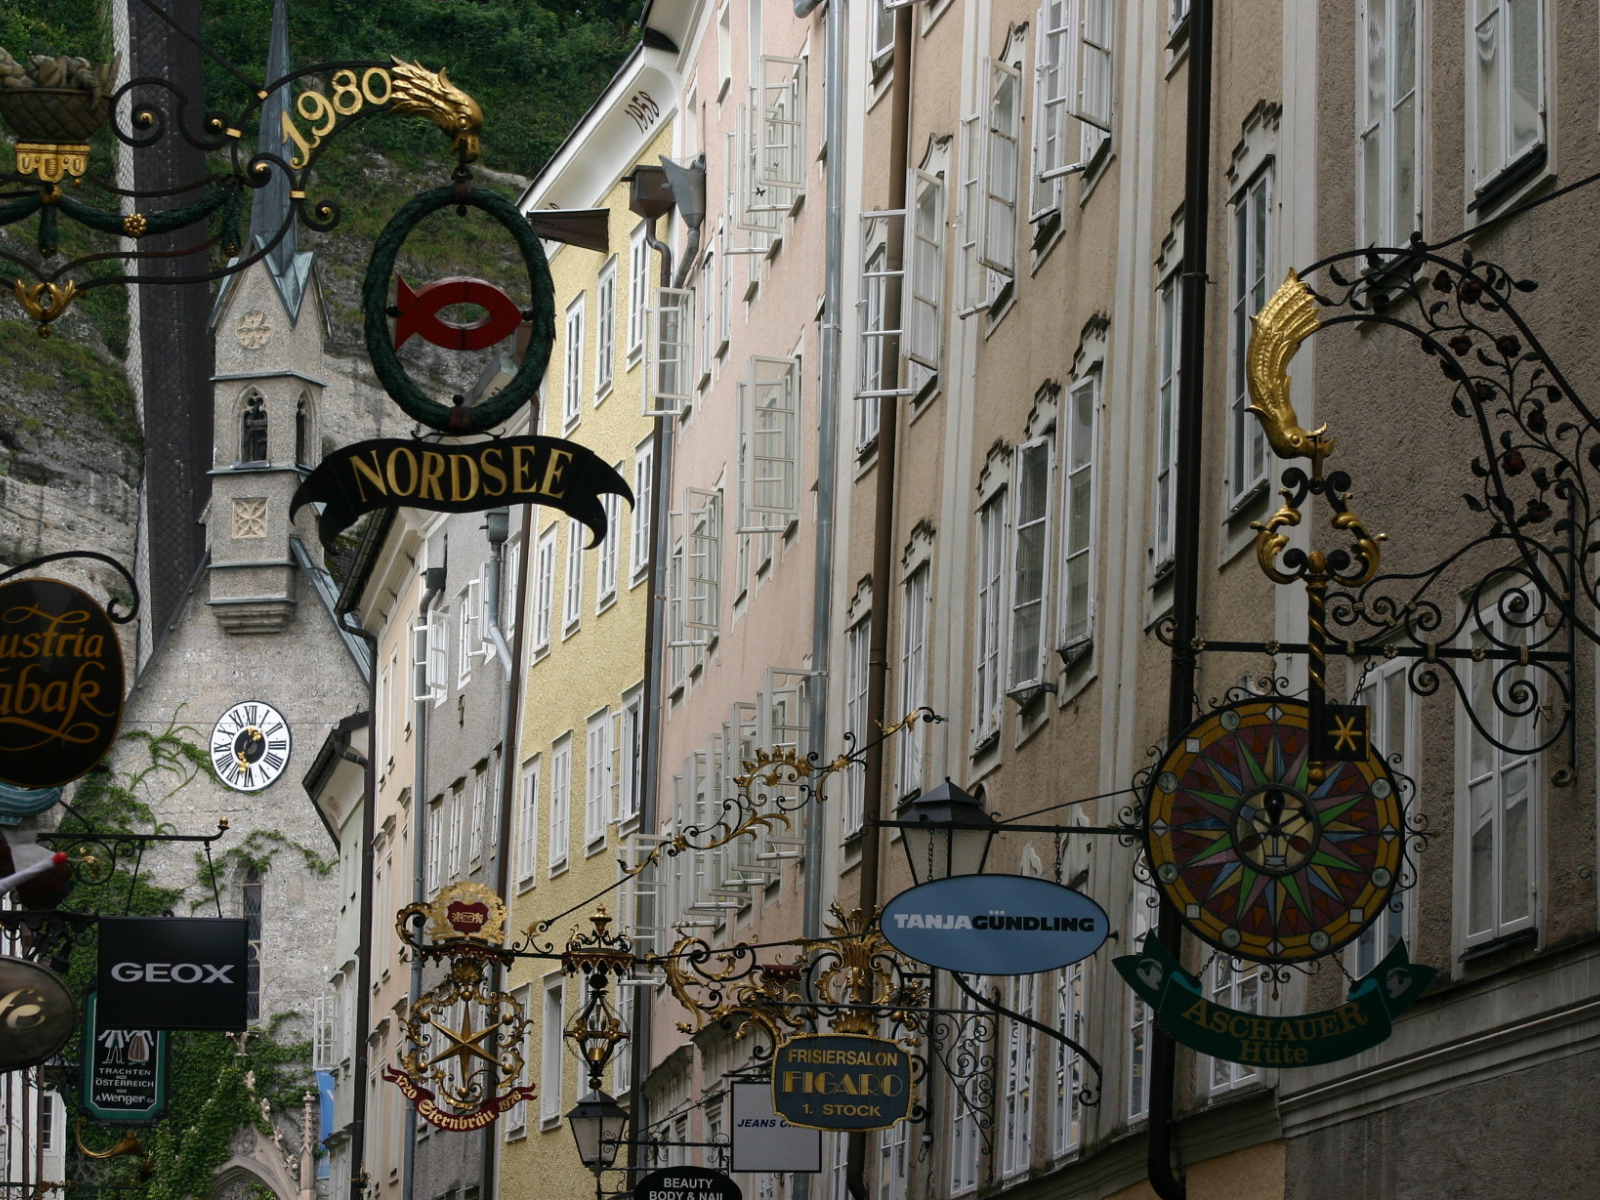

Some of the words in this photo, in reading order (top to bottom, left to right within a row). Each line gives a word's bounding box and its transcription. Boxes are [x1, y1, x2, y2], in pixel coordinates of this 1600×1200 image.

[281, 67, 391, 169] 1980
[624, 91, 659, 134] 1958
[349, 446, 573, 502] NORDSEE
[0, 603, 104, 658] ustria
[0, 661, 115, 735] abak
[111, 962, 235, 983] GEOX
[1180, 999, 1368, 1041] ASCHAUER
[788, 1049, 899, 1067] FRISIERSALON
[1238, 1039, 1309, 1064] Hüte
[95, 1077, 154, 1088] ÖSTERREICH
[99, 1067, 151, 1076] TRACHTEN
[394, 1075, 418, 1099] 1720
[782, 1071, 903, 1097] FIGARO
[497, 1090, 522, 1112] 1976
[802, 1103, 814, 1115] 1.
[822, 1104, 882, 1117] STOCK
[418, 1098, 496, 1130] Sternbräu
[737, 1119, 776, 1128] JEANS
[649, 1191, 684, 1200] BODY
[663, 1178, 714, 1189] BEAUTY
